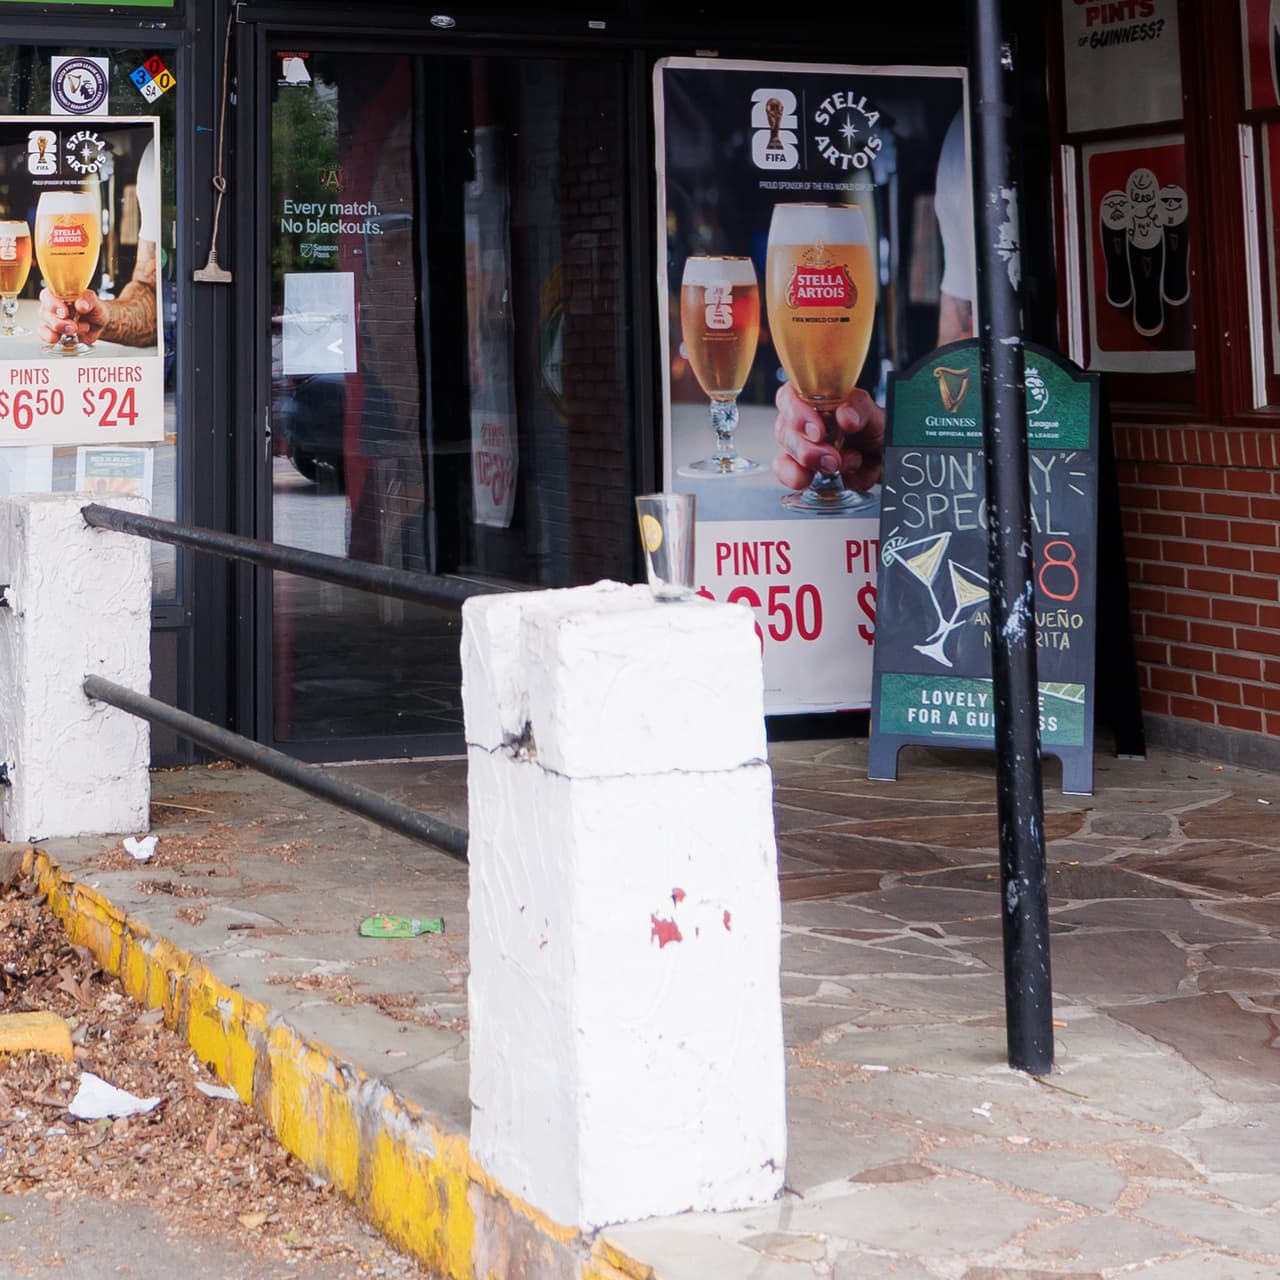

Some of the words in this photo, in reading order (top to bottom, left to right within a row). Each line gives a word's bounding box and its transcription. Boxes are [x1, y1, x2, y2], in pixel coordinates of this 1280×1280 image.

[1089, 19, 1166, 49] GUINNESS?
[149, 59, 159, 75] 0
[135, 69, 146, 85] 3
[159, 73, 170, 88] 0
[145, 85, 156, 97] SA
[815, 91, 881, 127] STELLA
[66, 130, 106, 151] STELLA
[765, 153, 787, 163] FIFA
[814, 134, 882, 170] ARTOIS
[66, 154, 107, 174] ARTOIS
[283, 199, 327, 218] Every
[329, 200, 381, 216] match.
[280, 218, 303, 233] No
[308, 218, 384, 235] blackouts.
[313, 244, 339, 252] Season
[797, 274, 844, 286] STELLA
[796, 286, 845, 298] ARTOIS
[10, 368, 50, 385] PINTS
[78, 366, 142, 384] PITCHERS
[82, 387, 139, 428] $24
[925, 416, 976, 427] GUINNESS
[1029, 419, 1059, 429] League
[715, 540, 792, 576] PINTS
[922, 690, 988, 708] LOVELY
[908, 708, 941, 725] FOR
[948, 711, 958, 725] A
